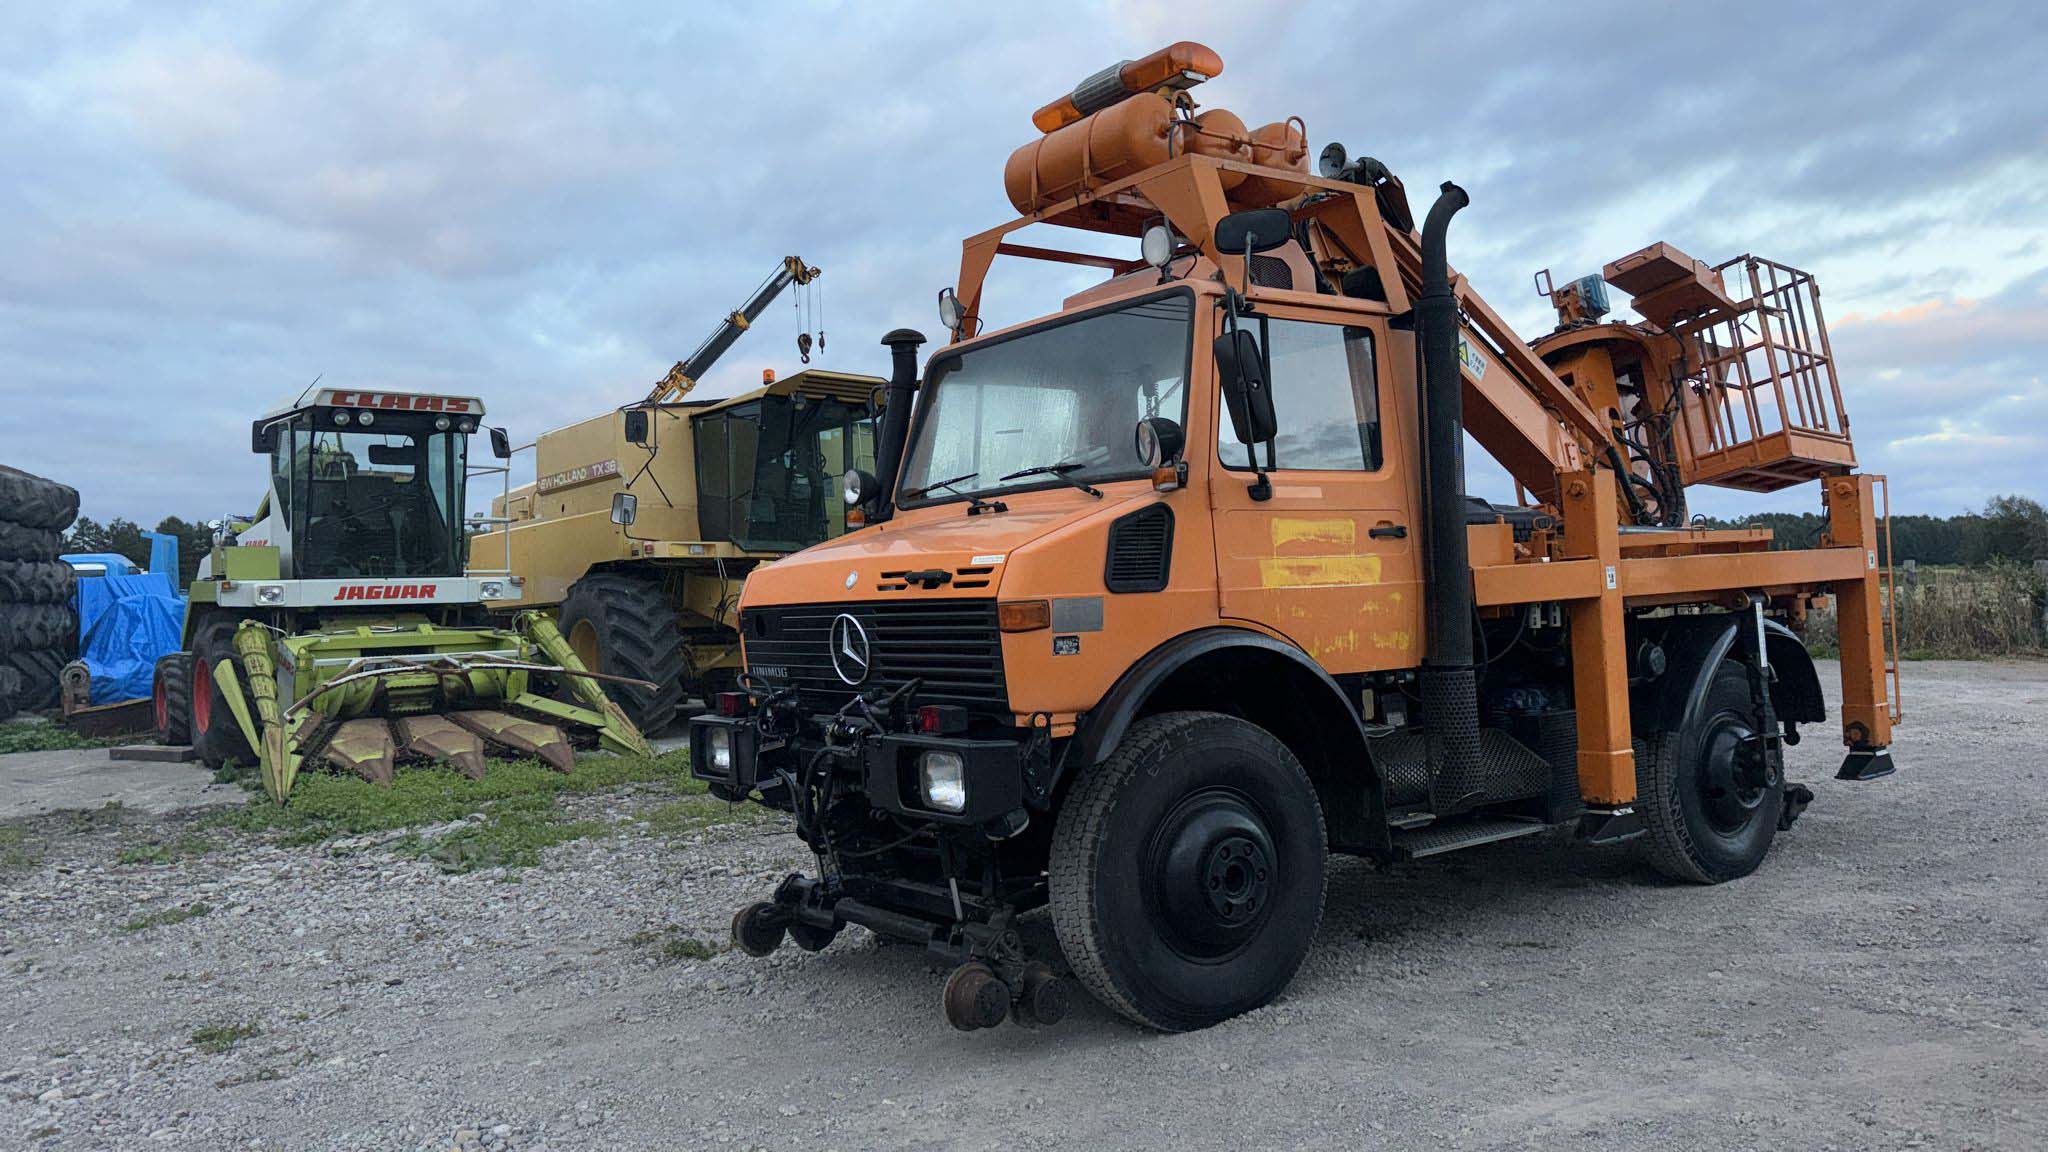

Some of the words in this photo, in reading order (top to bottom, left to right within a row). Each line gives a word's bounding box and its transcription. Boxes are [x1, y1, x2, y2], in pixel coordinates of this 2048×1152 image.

[331, 391, 470, 412] CLAAS
[553, 468, 587, 486] HOLLAND
[592, 465, 604, 476] TX
[333, 585, 437, 600] JAGUAR
[752, 666, 788, 678] UNIMOG
